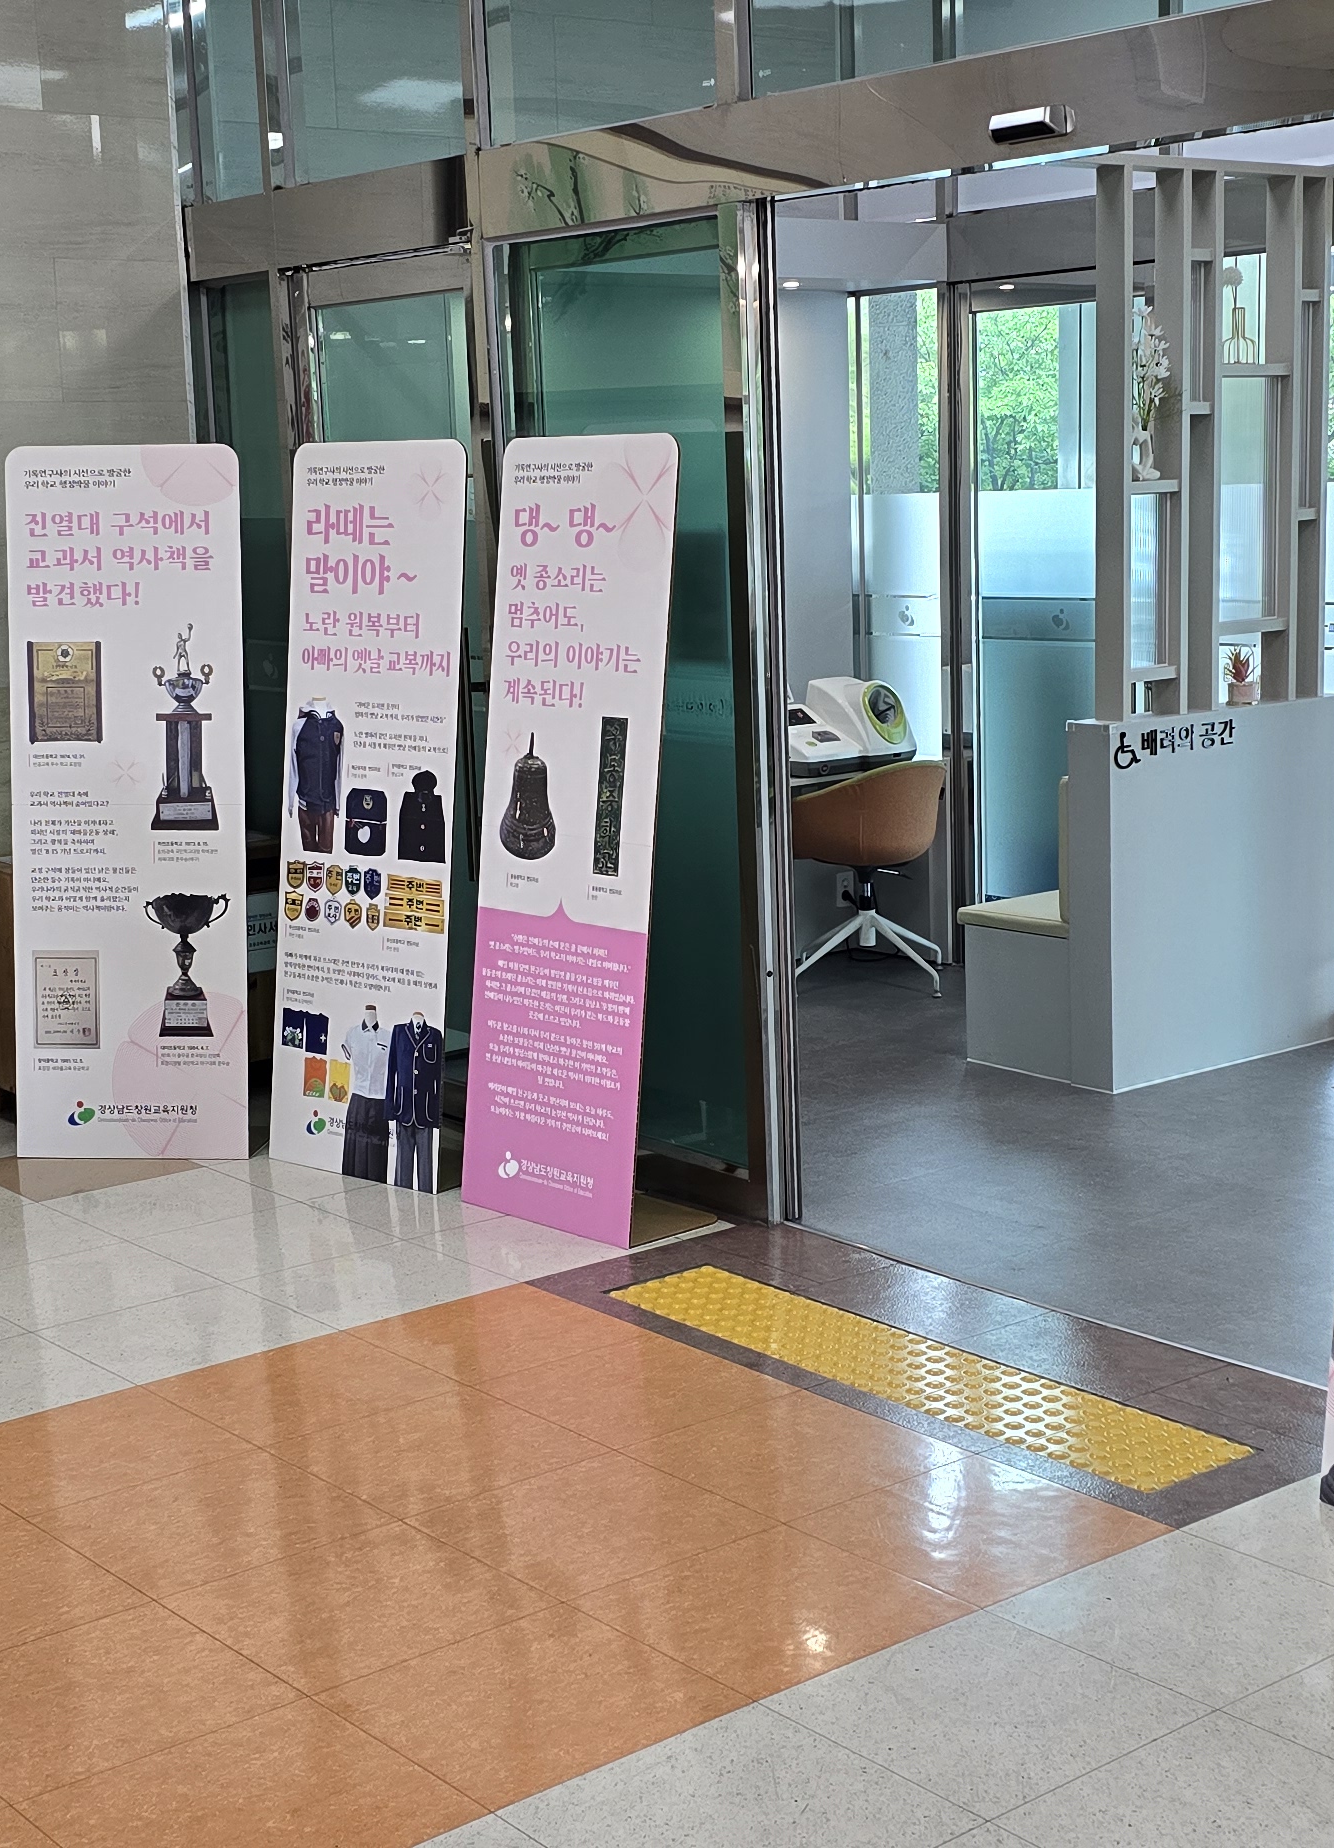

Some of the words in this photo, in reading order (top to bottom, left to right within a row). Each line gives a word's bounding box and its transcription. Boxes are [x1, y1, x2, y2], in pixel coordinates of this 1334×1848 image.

[24, 470, 71, 478] 기록연구사의
[107, 469, 132, 477] 발굴한
[24, 511, 101, 538] 진열대
[110, 510, 211, 537] 구석에서
[306, 503, 395, 546] 라떼는
[515, 503, 560, 547] 댕~
[569, 502, 616, 548] 댕~
[26, 546, 103, 571] 교과서
[112, 545, 214, 571] 역사책을
[511, 563, 527, 591] 옛
[534, 563, 606, 592] 종소리는
[27, 581, 141, 608] 발견했다!
[303, 610, 340, 637] 노란
[346, 611, 420, 639] 원복부터
[508, 601, 584, 632] 멈추어도,
[302, 645, 349, 672] 아빠의
[352, 648, 384, 674] 옛날
[387, 650, 451, 677] 교복까지
[505, 640, 559, 668] 우리의
[566, 643, 641, 674] 이야기는
[504, 678, 584, 708] 계속된다!
[1141, 724, 1194, 756] 배려의
[1199, 719, 1235, 749] 공간
[98, 1104, 198, 1115] 경상남도창원교육지원청
[520, 1159, 594, 1189] 경상남도창원교육지원청
